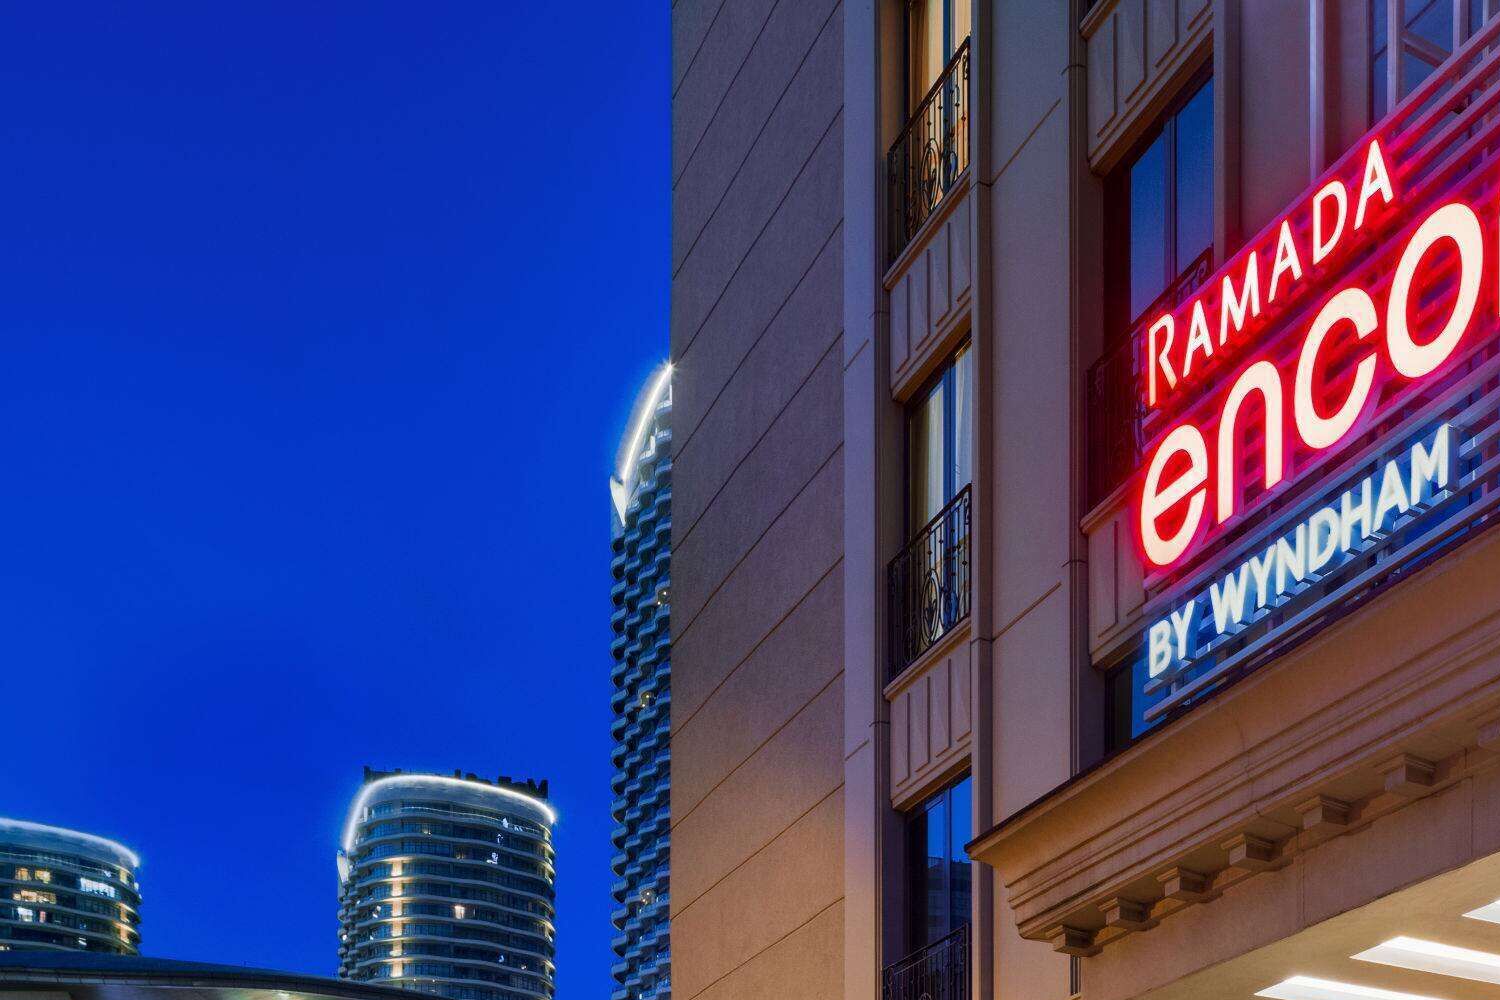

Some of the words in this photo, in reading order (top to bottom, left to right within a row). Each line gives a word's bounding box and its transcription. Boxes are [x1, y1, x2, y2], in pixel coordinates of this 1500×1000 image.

[1148, 139, 1394, 404] RAMADA
[1148, 599, 1195, 679] BY
[1209, 422, 1451, 635] WYNDHAM
